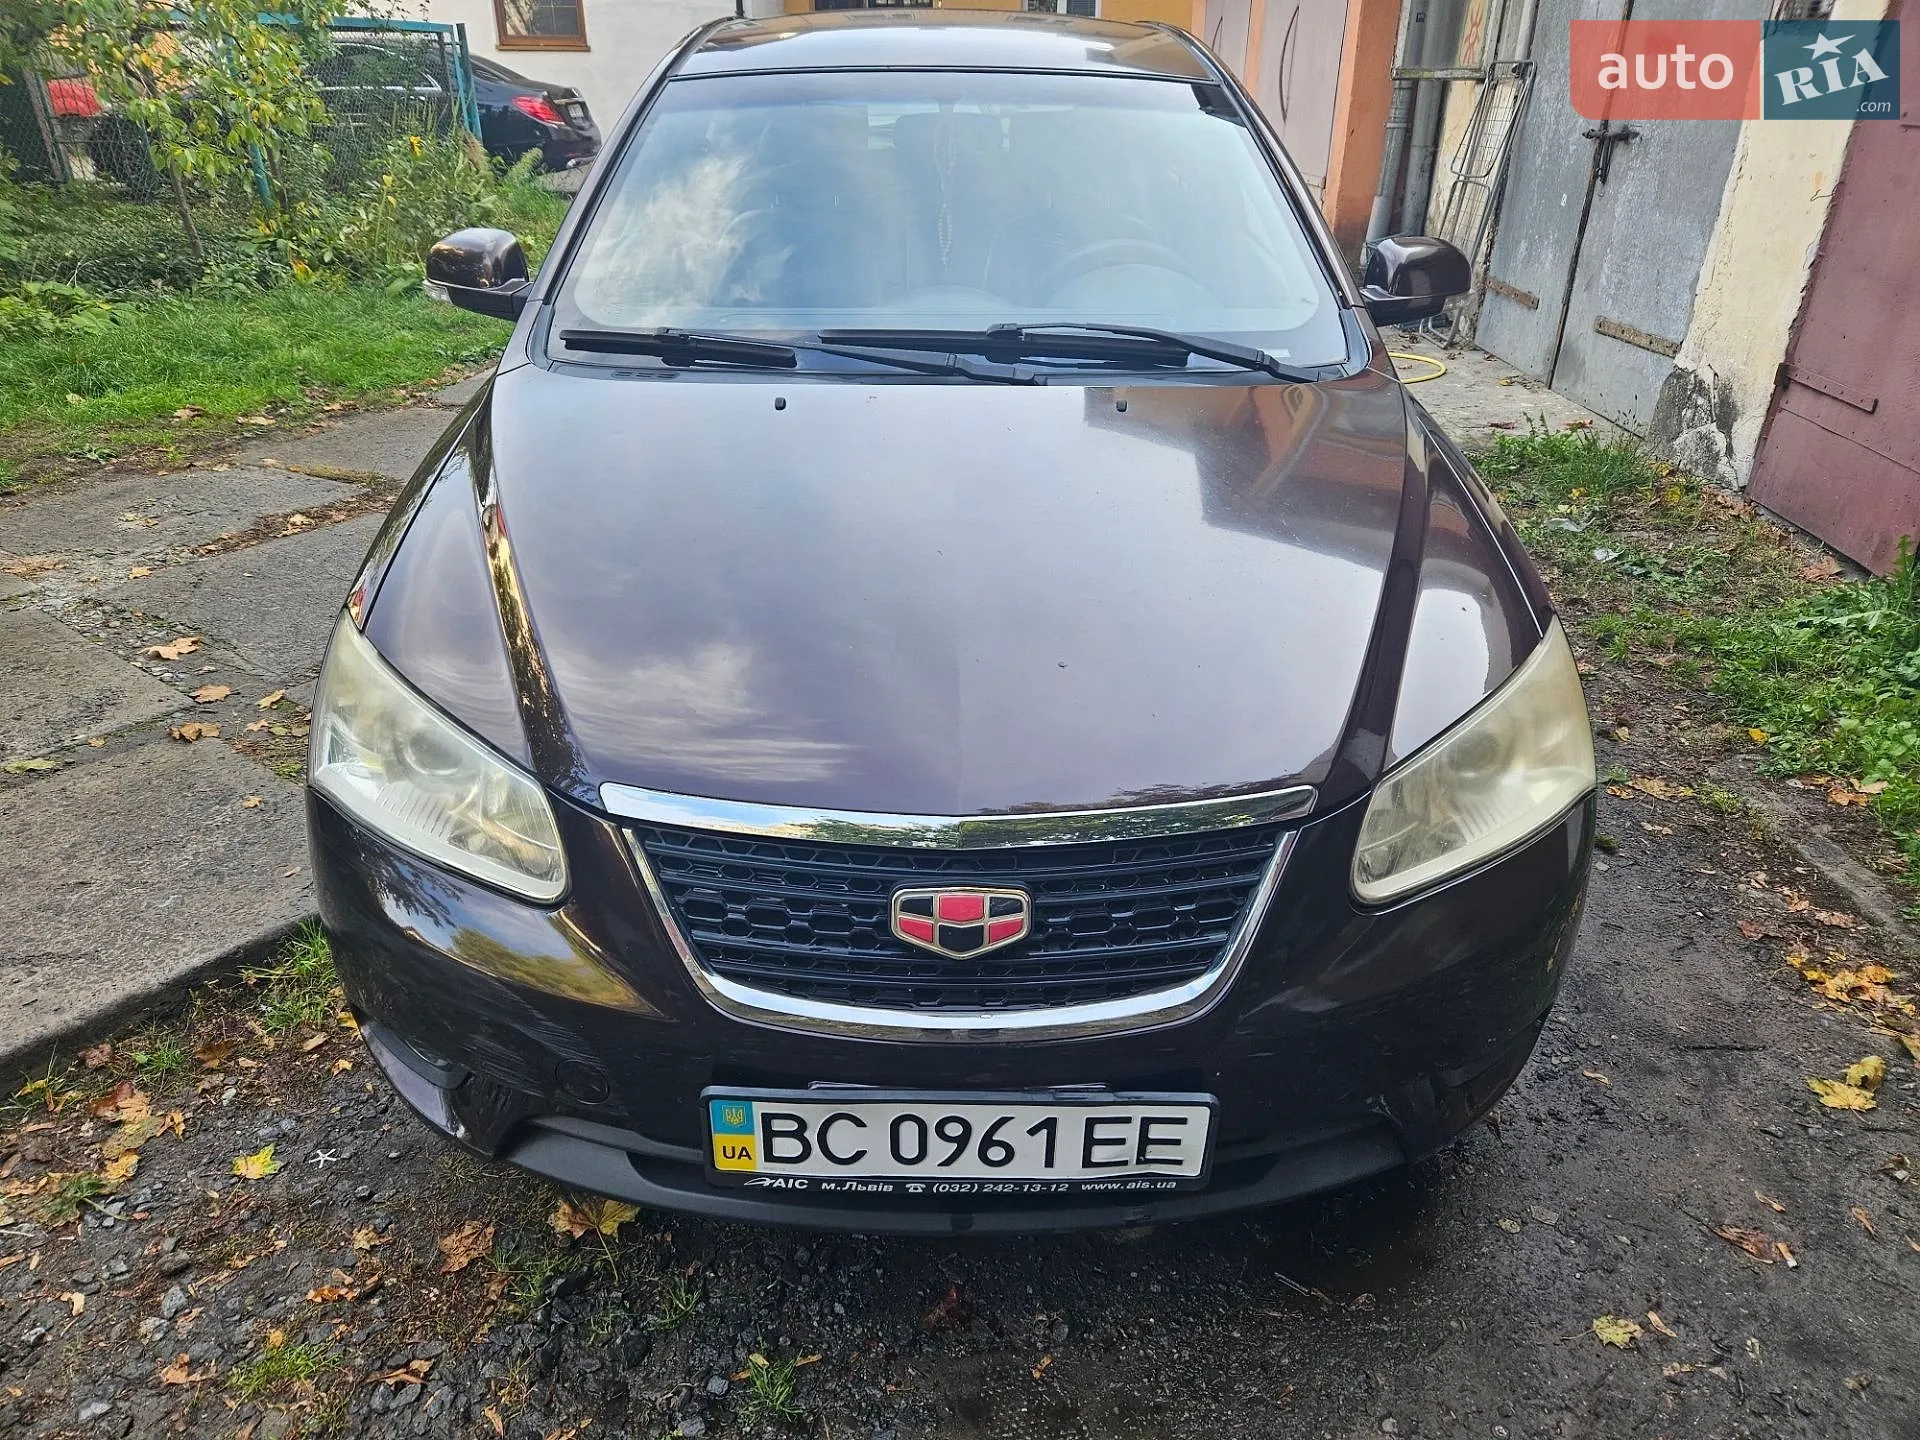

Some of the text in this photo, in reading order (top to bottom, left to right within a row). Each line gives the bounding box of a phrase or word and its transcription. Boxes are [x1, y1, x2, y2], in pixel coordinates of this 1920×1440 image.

[760, 1112, 1189, 1170] BC 0961 EE
[722, 1145, 752, 1161] UA
[932, 1183, 979, 1194] (032)
[982, 1182, 1069, 1193] 242-13-12
[1081, 1180, 1177, 1191] www.ais.ua
